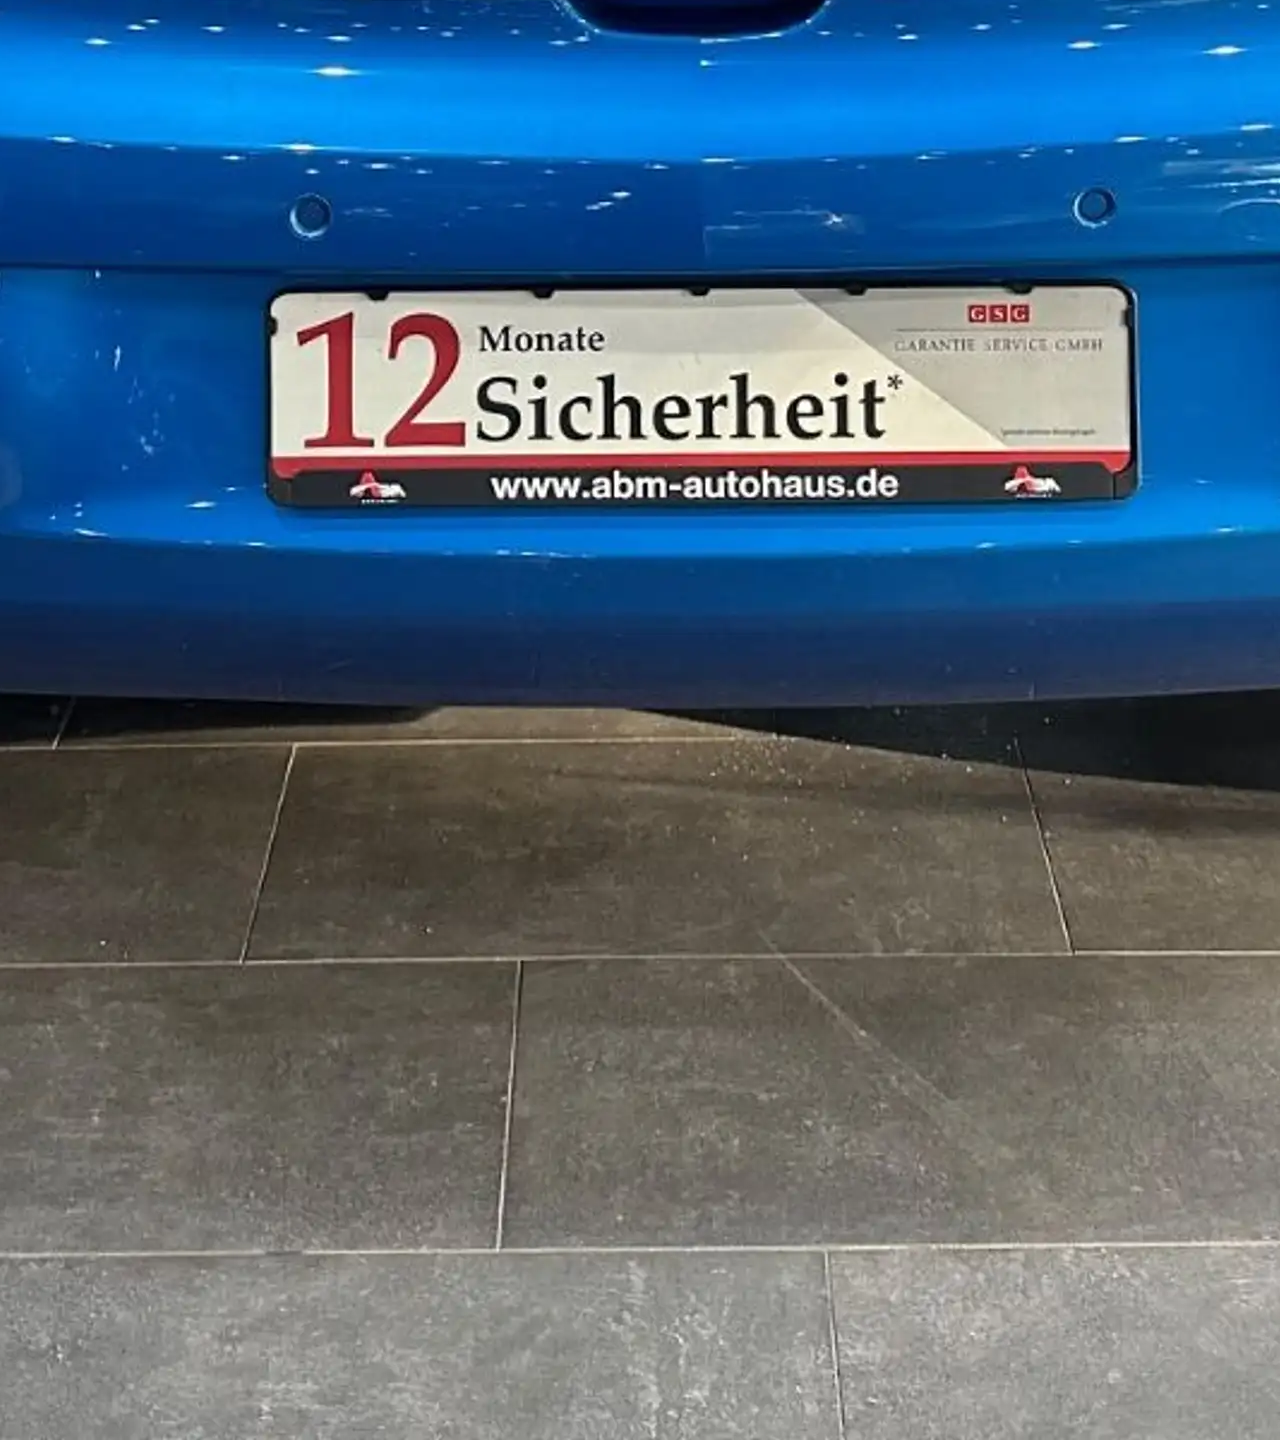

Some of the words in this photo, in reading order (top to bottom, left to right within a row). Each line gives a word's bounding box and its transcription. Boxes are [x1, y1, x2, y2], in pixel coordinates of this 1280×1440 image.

[968, 305, 1029, 322] GSG
[894, 338, 977, 352] GARANTIE
[984, 338, 1047, 352] SERVICE
[296, 311, 466, 448] 12
[478, 324, 605, 352] Monate
[490, 469, 900, 500] www.abm-autohaus.de
